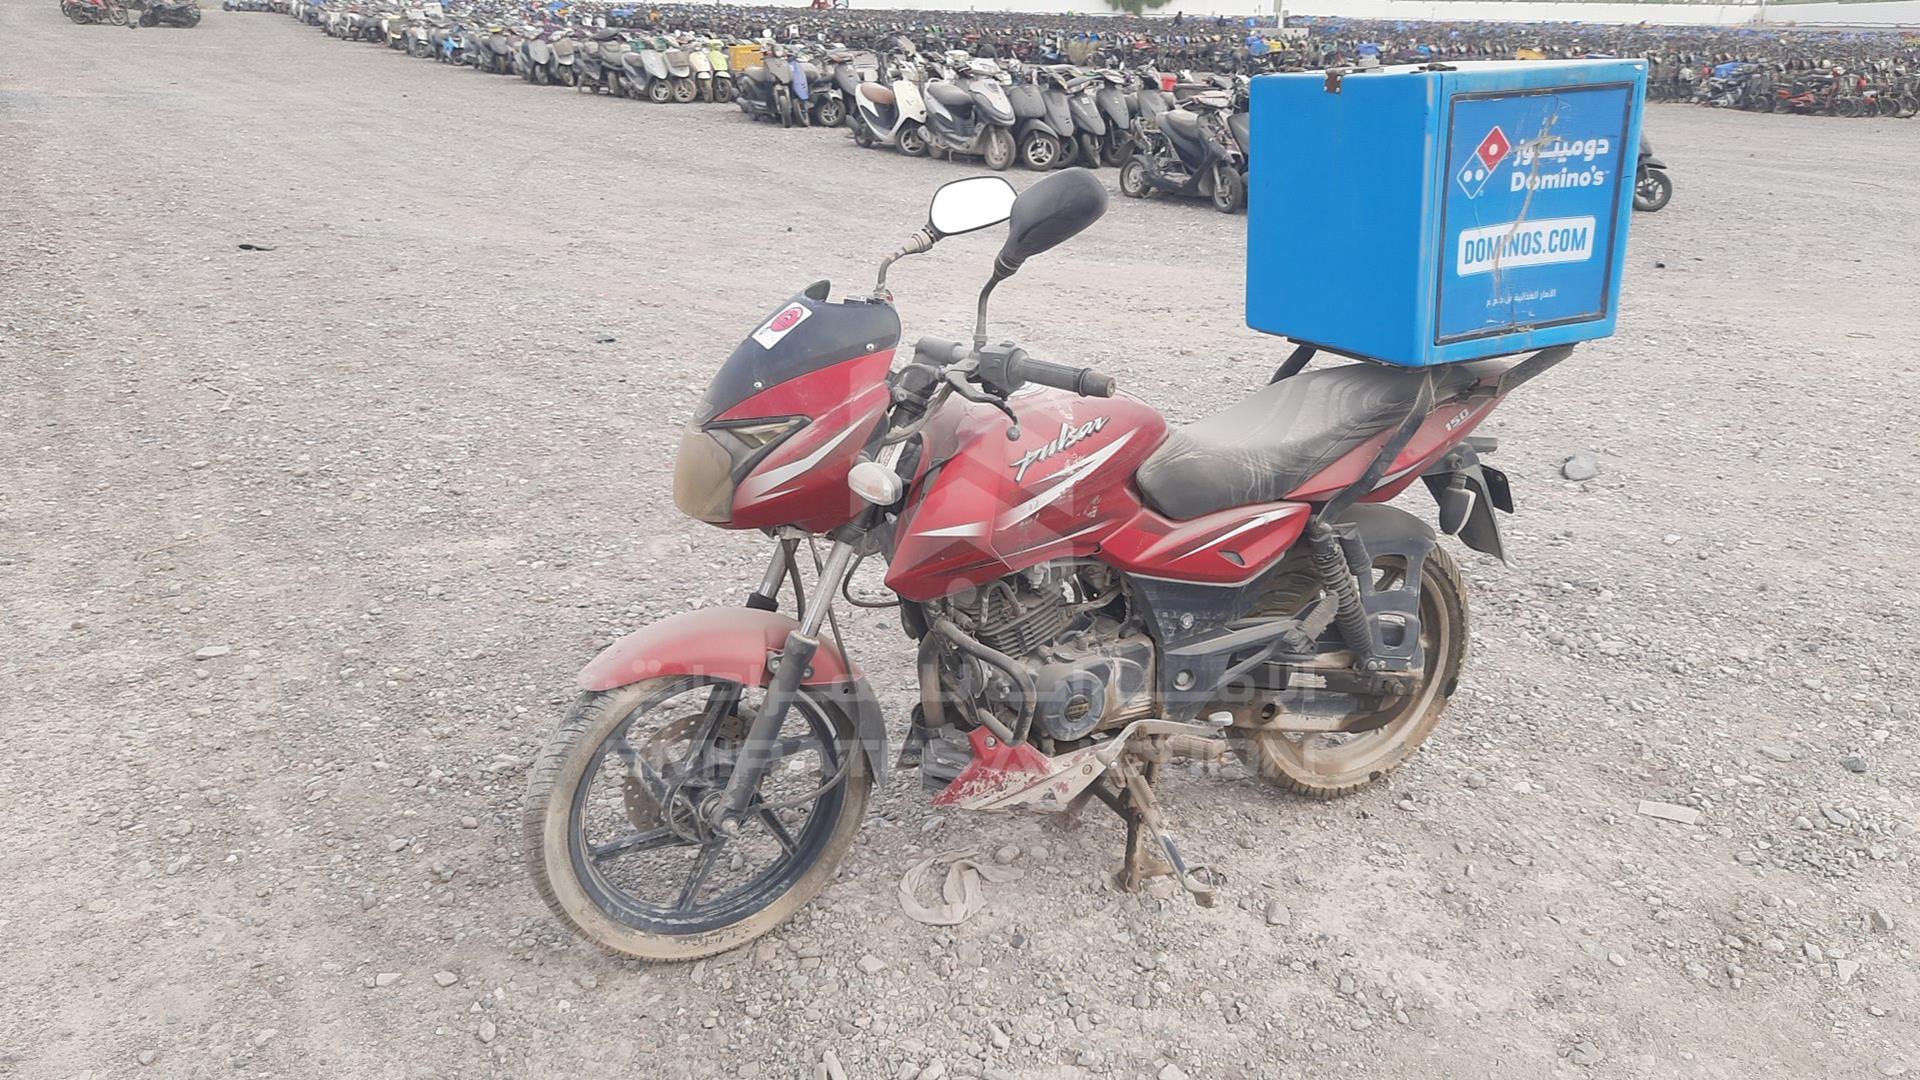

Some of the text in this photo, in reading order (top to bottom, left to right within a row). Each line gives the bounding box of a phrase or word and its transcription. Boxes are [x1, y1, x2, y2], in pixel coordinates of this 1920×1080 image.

[1510, 165, 1605, 192] Domino's
[1464, 227, 1588, 264] DOMINOS.COM
[1444, 408, 1470, 432] 150
